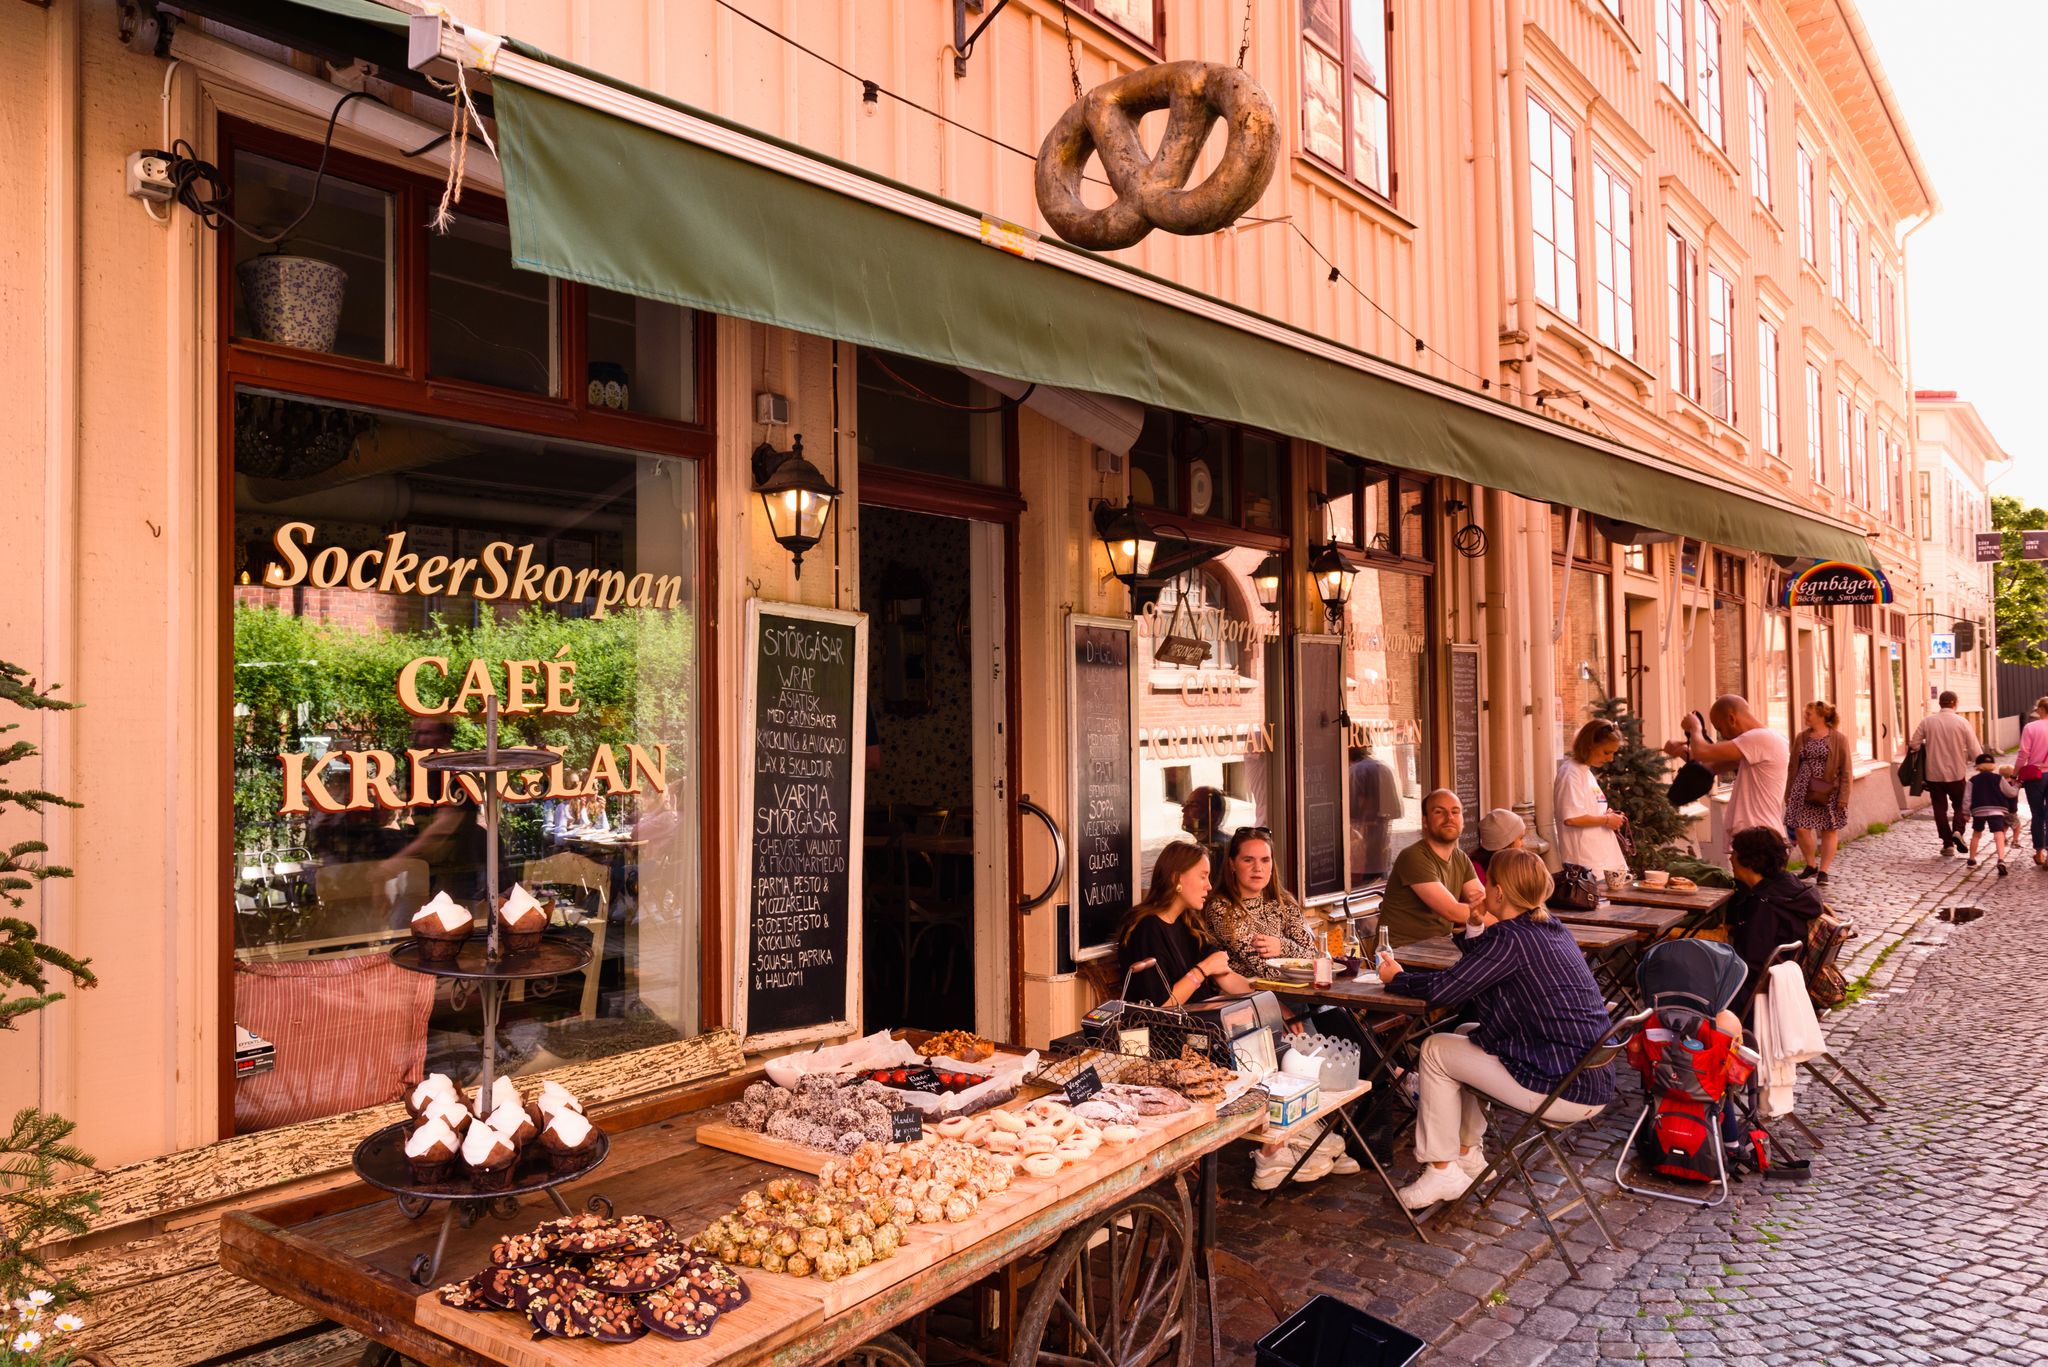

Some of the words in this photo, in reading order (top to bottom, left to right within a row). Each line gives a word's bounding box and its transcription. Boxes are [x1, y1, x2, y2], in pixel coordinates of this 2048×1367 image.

[264, 521, 683, 619] SockerSkorpan
[1786, 576, 1886, 594] Regnbågens
[1837, 593, 1874, 602] Smycken
[763, 626, 844, 664] SMÖRGÅSAR
[397, 644, 581, 717] CAFÉ
[778, 665, 815, 690] WRAP
[1181, 664, 1242, 708] CAFÉ
[767, 708, 785, 724] MED
[1146, 722, 1275, 761] KRINGLAN
[1348, 719, 1423, 748] RINGLAN
[802, 734, 808, 751] &
[809, 734, 847, 754] AVOKADO
[758, 754, 777, 773] LAX
[780, 757, 785, 774] &
[789, 757, 834, 778] SKALDJUR
[774, 784, 830, 809] VARMA
[1089, 800, 1115, 819] SOPPA
[756, 807, 838, 835] SMÖRGÅSAR
[1083, 820, 1120, 836] VEGETARISK
[806, 839, 842, 855] VALNÖT
[1096, 837, 1110, 853] FISK
[759, 856, 766, 873] &
[769, 856, 845, 873] FIKONMARMELAD
[1089, 853, 1119, 870] GULASCH
[794, 876, 821, 893] PESTO
[823, 877, 829, 893] &
[1084, 882, 1125, 906] VÄLKOMNA
[758, 895, 821, 915] MOZZARELLA
[823, 913, 829, 928] &
[757, 934, 801, 951] KYCKLING
[798, 949, 833, 968] PAPRIKA
[755, 975, 762, 990] &
[765, 971, 803, 989] HALLOMI
